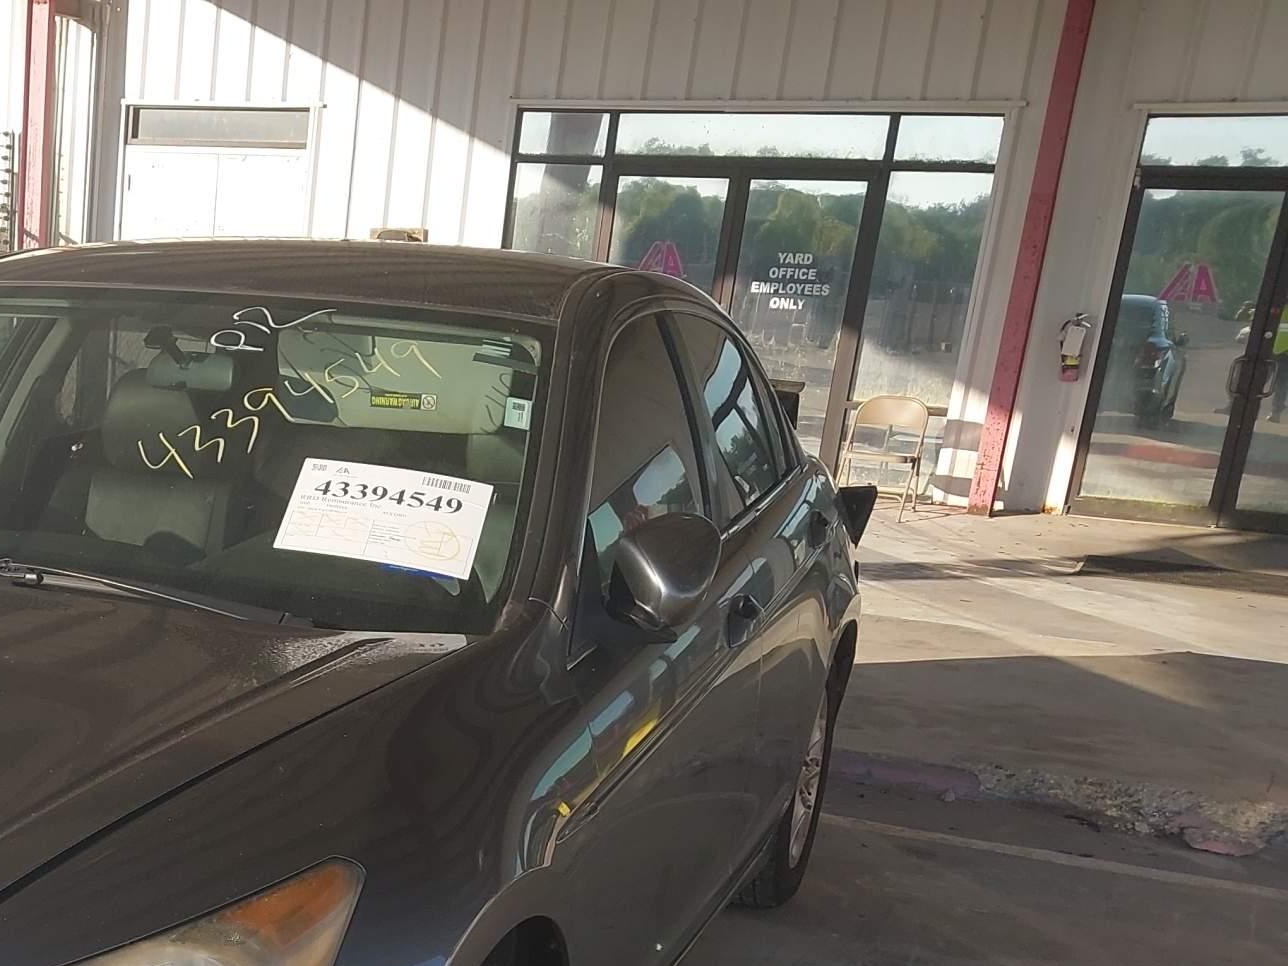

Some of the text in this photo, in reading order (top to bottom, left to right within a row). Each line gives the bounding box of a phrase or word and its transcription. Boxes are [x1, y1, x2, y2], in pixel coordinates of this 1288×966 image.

[778, 252, 814, 265] YARD
[769, 267, 817, 280] OFFICE
[750, 281, 831, 296] EMPLOYEES
[769, 297, 806, 310] ONLY
[137, 340, 442, 479] 43394549
[314, 479, 464, 514] 43394549
